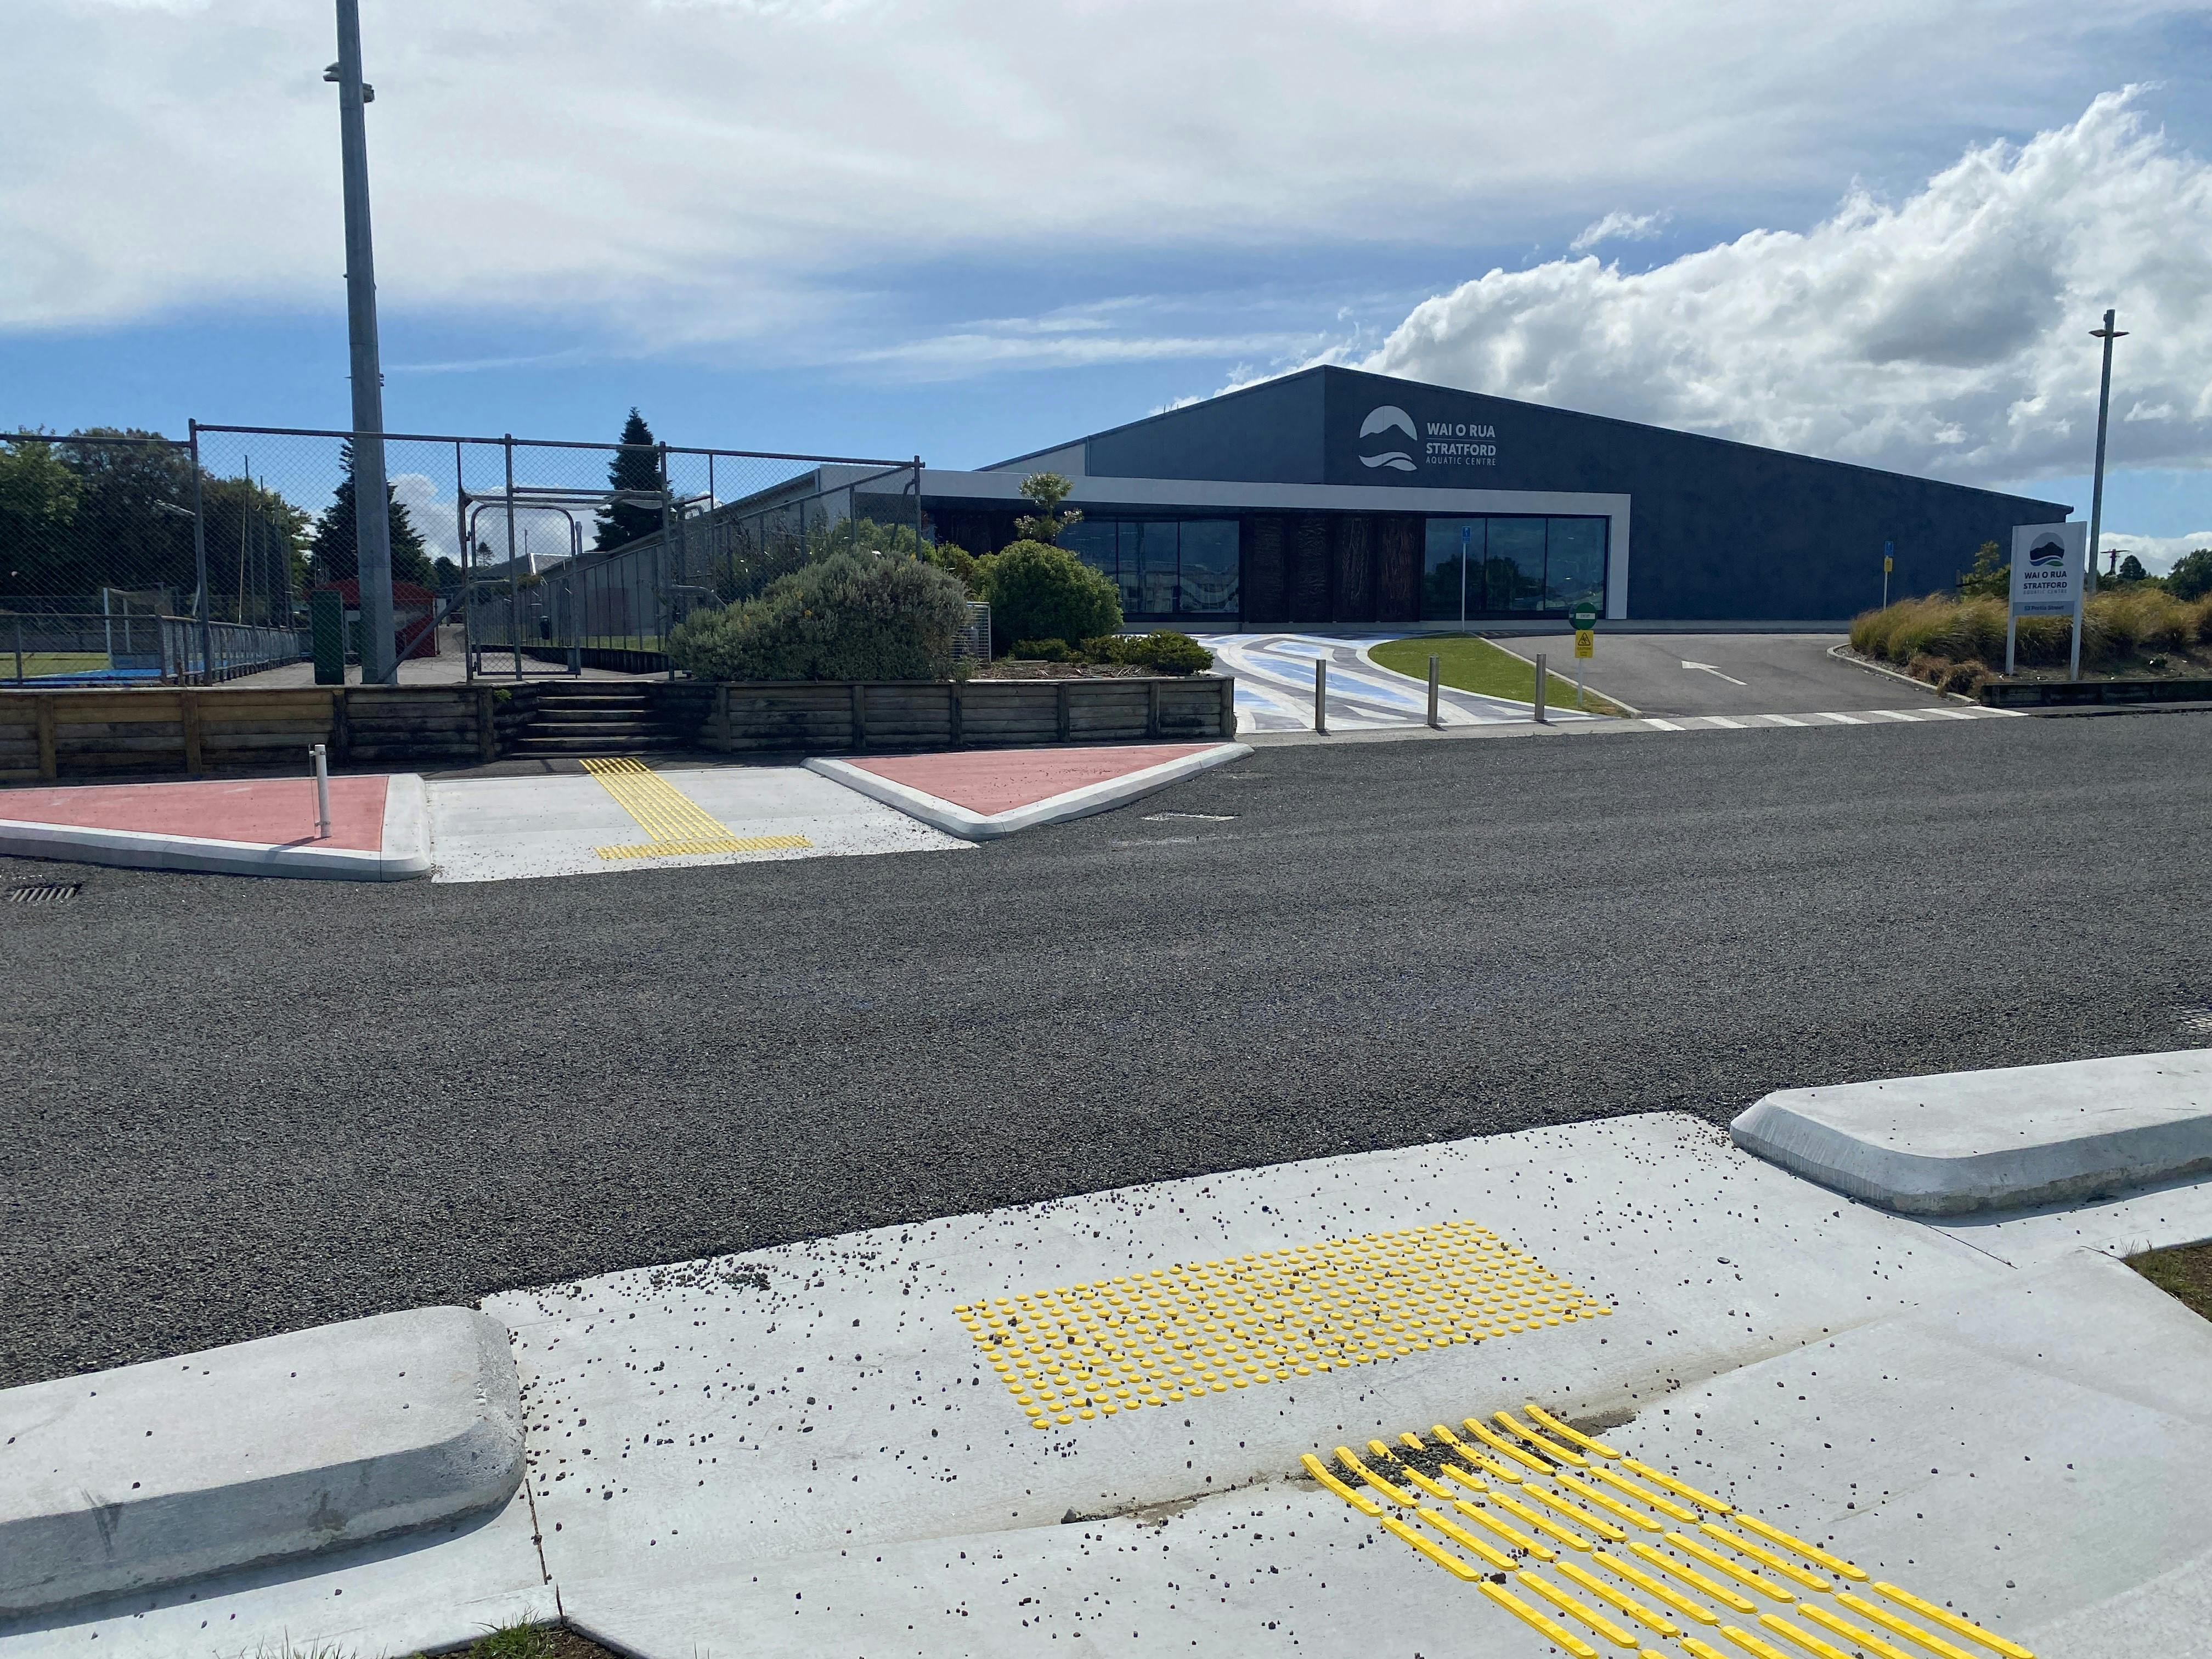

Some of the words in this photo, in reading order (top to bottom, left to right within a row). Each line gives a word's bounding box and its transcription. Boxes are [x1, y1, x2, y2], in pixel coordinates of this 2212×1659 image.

[1427, 422, 1452, 436] WAI
[1455, 424, 1466, 436] O
[1470, 424, 1496, 437] RUA
[1426, 442, 1496, 456] STRATFORD
[1426, 456, 1462, 465] AQUATIC
[1465, 457, 1496, 466] CENTRE
